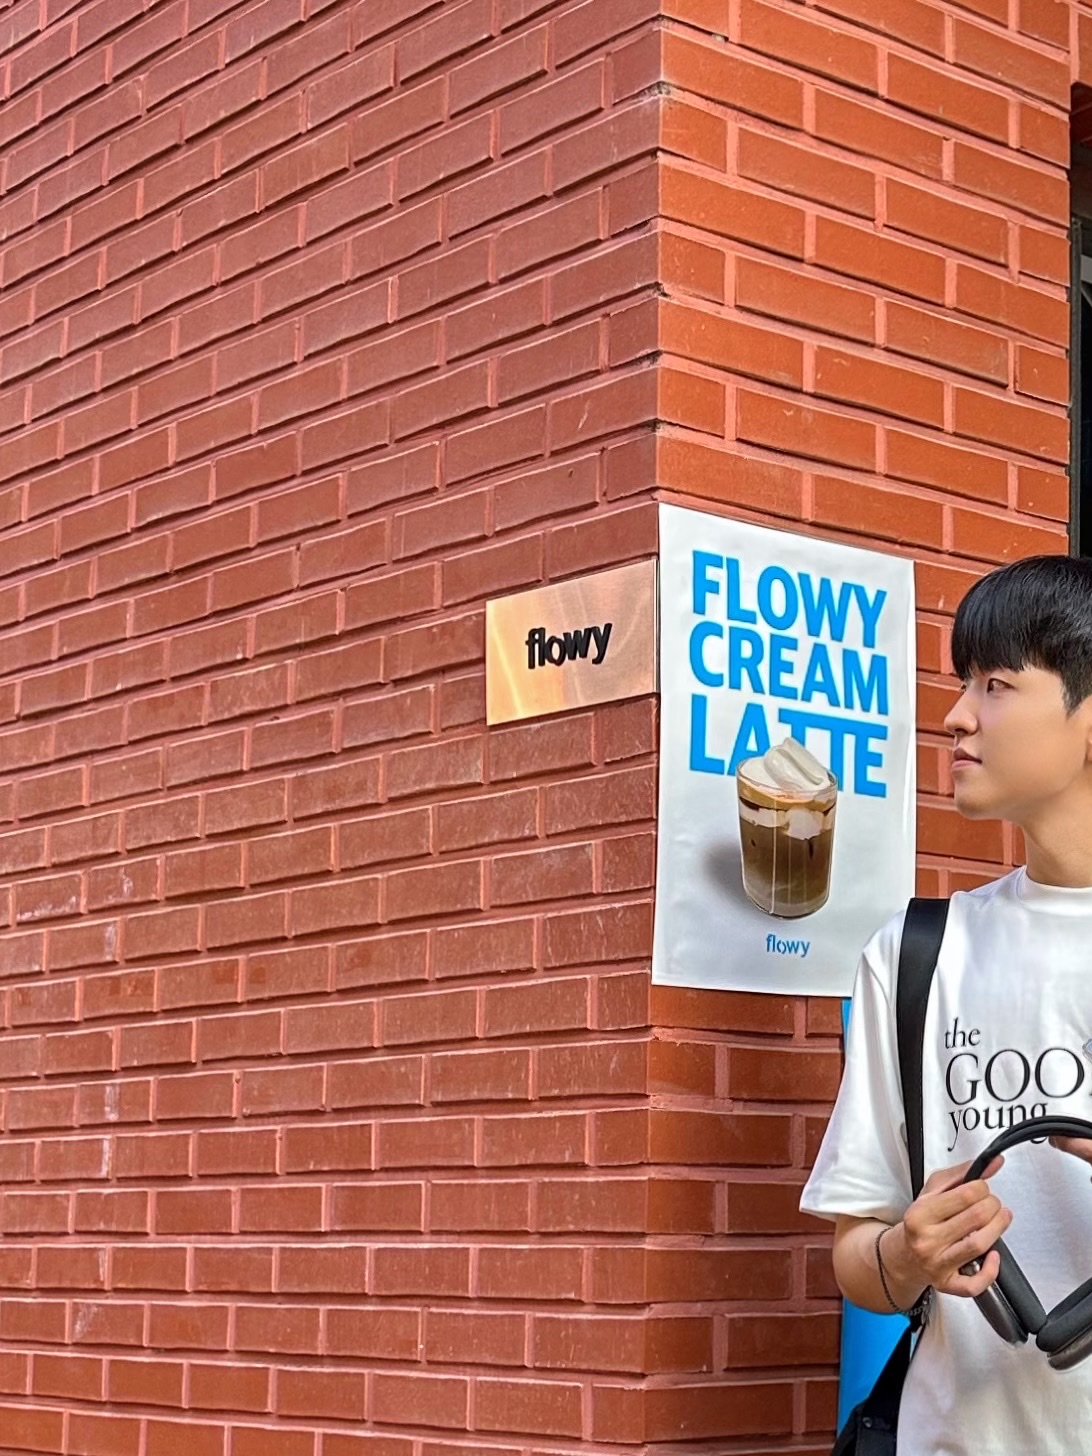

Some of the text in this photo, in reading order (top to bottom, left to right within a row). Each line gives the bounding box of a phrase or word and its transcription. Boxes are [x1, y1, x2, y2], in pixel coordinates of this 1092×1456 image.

[691, 549, 887, 648] FLOWY
[525, 622, 612, 670] flowy
[688, 621, 889, 716] CREAM
[766, 933, 811, 958] flowy
[944, 1016, 981, 1049] the
